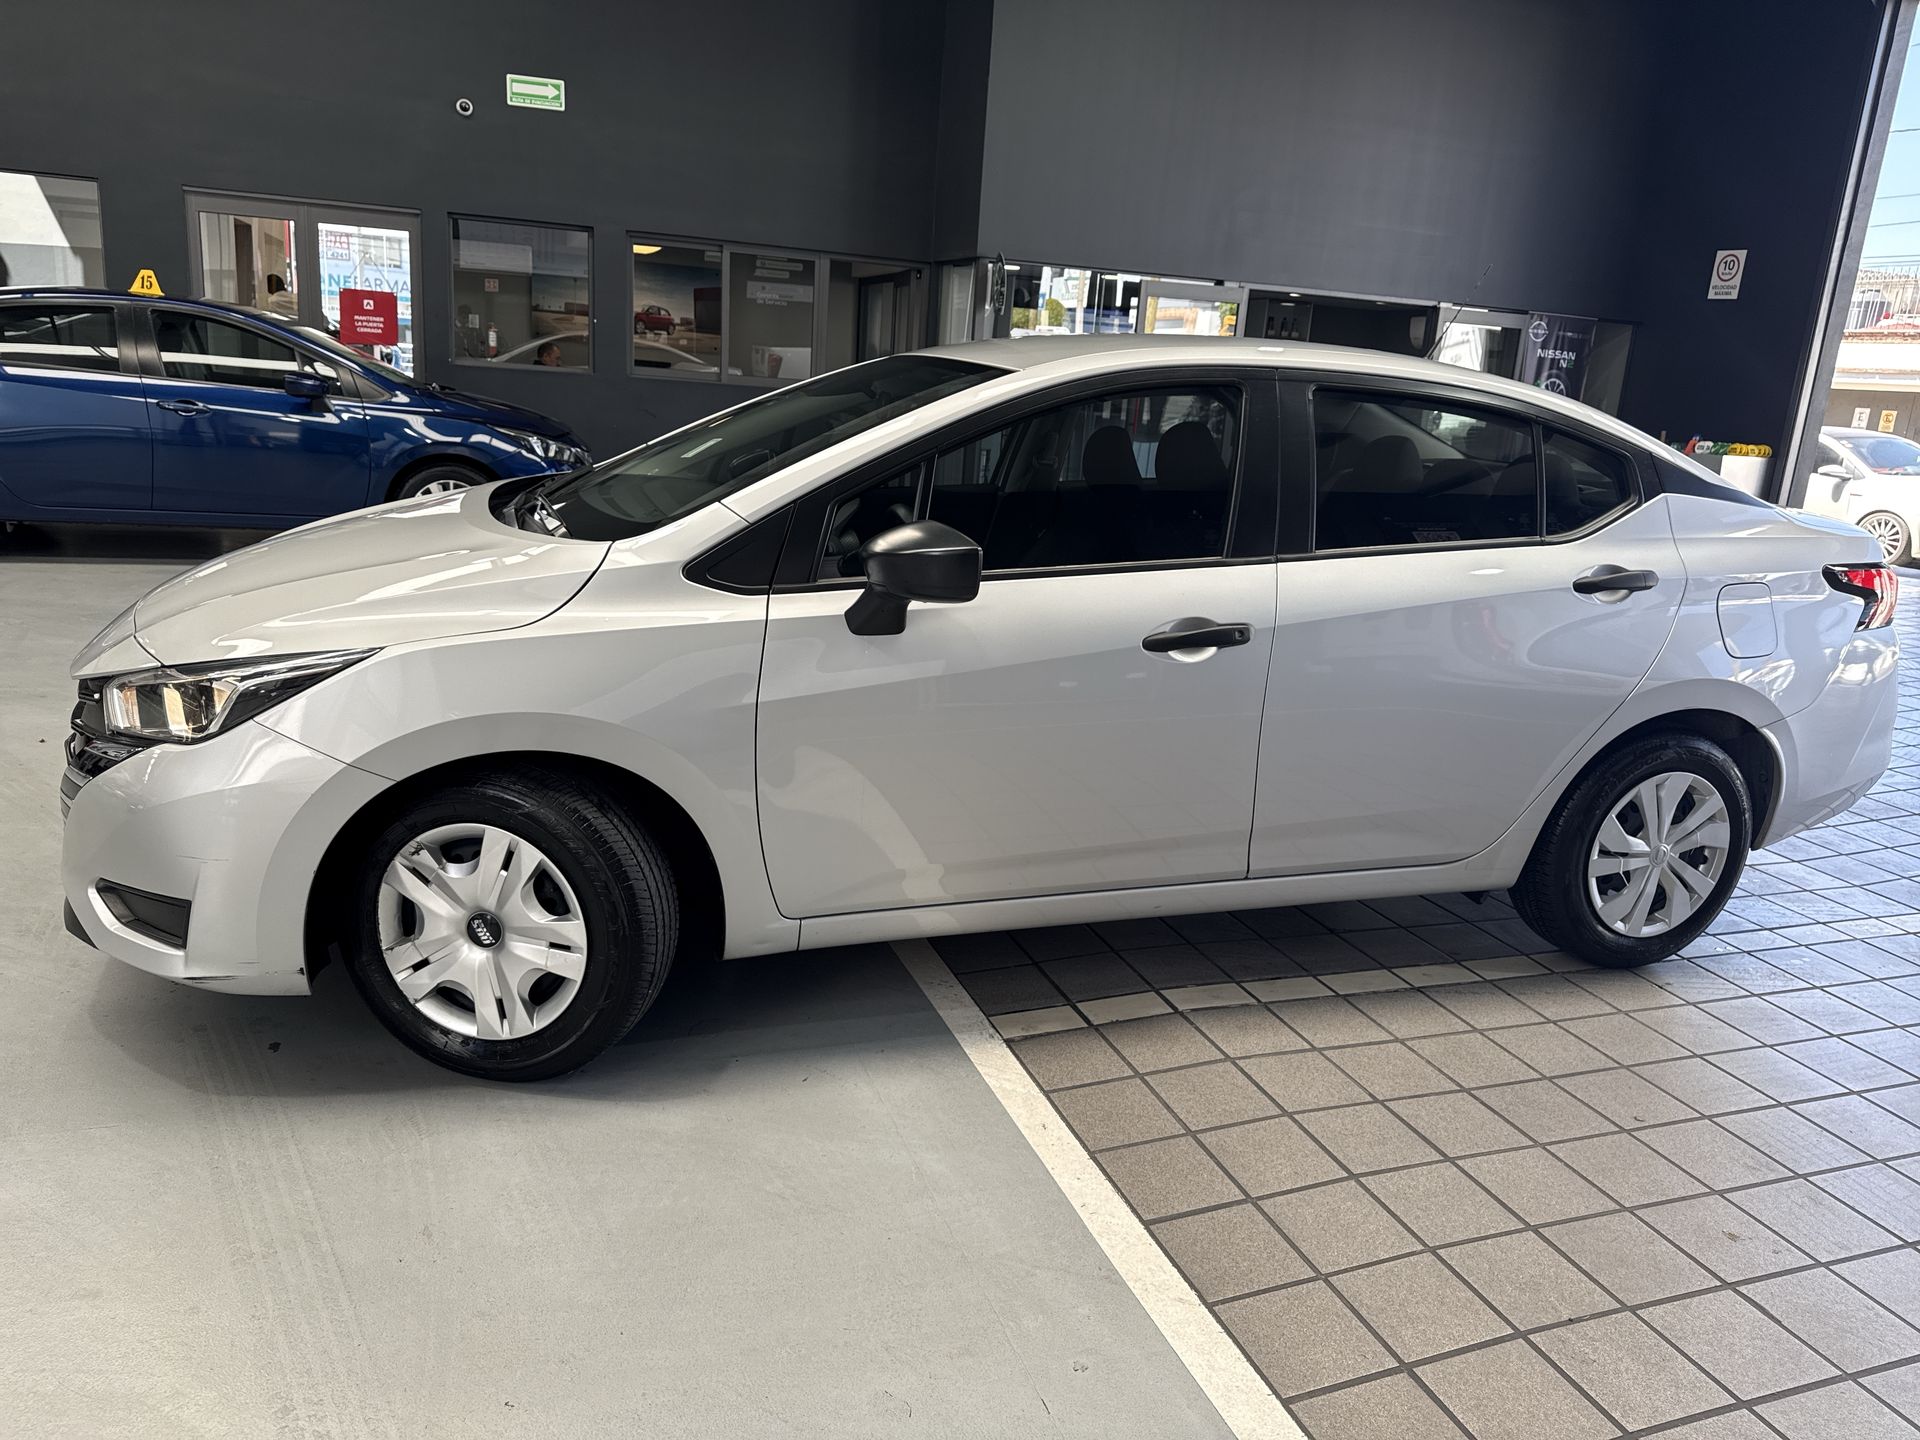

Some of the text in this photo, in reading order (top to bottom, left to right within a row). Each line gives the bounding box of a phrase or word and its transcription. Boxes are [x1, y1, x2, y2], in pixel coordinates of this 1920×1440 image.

[1723, 259, 1735, 271] 10
[141, 275, 153, 290] 15
[1537, 349, 1576, 361] NISSAN
